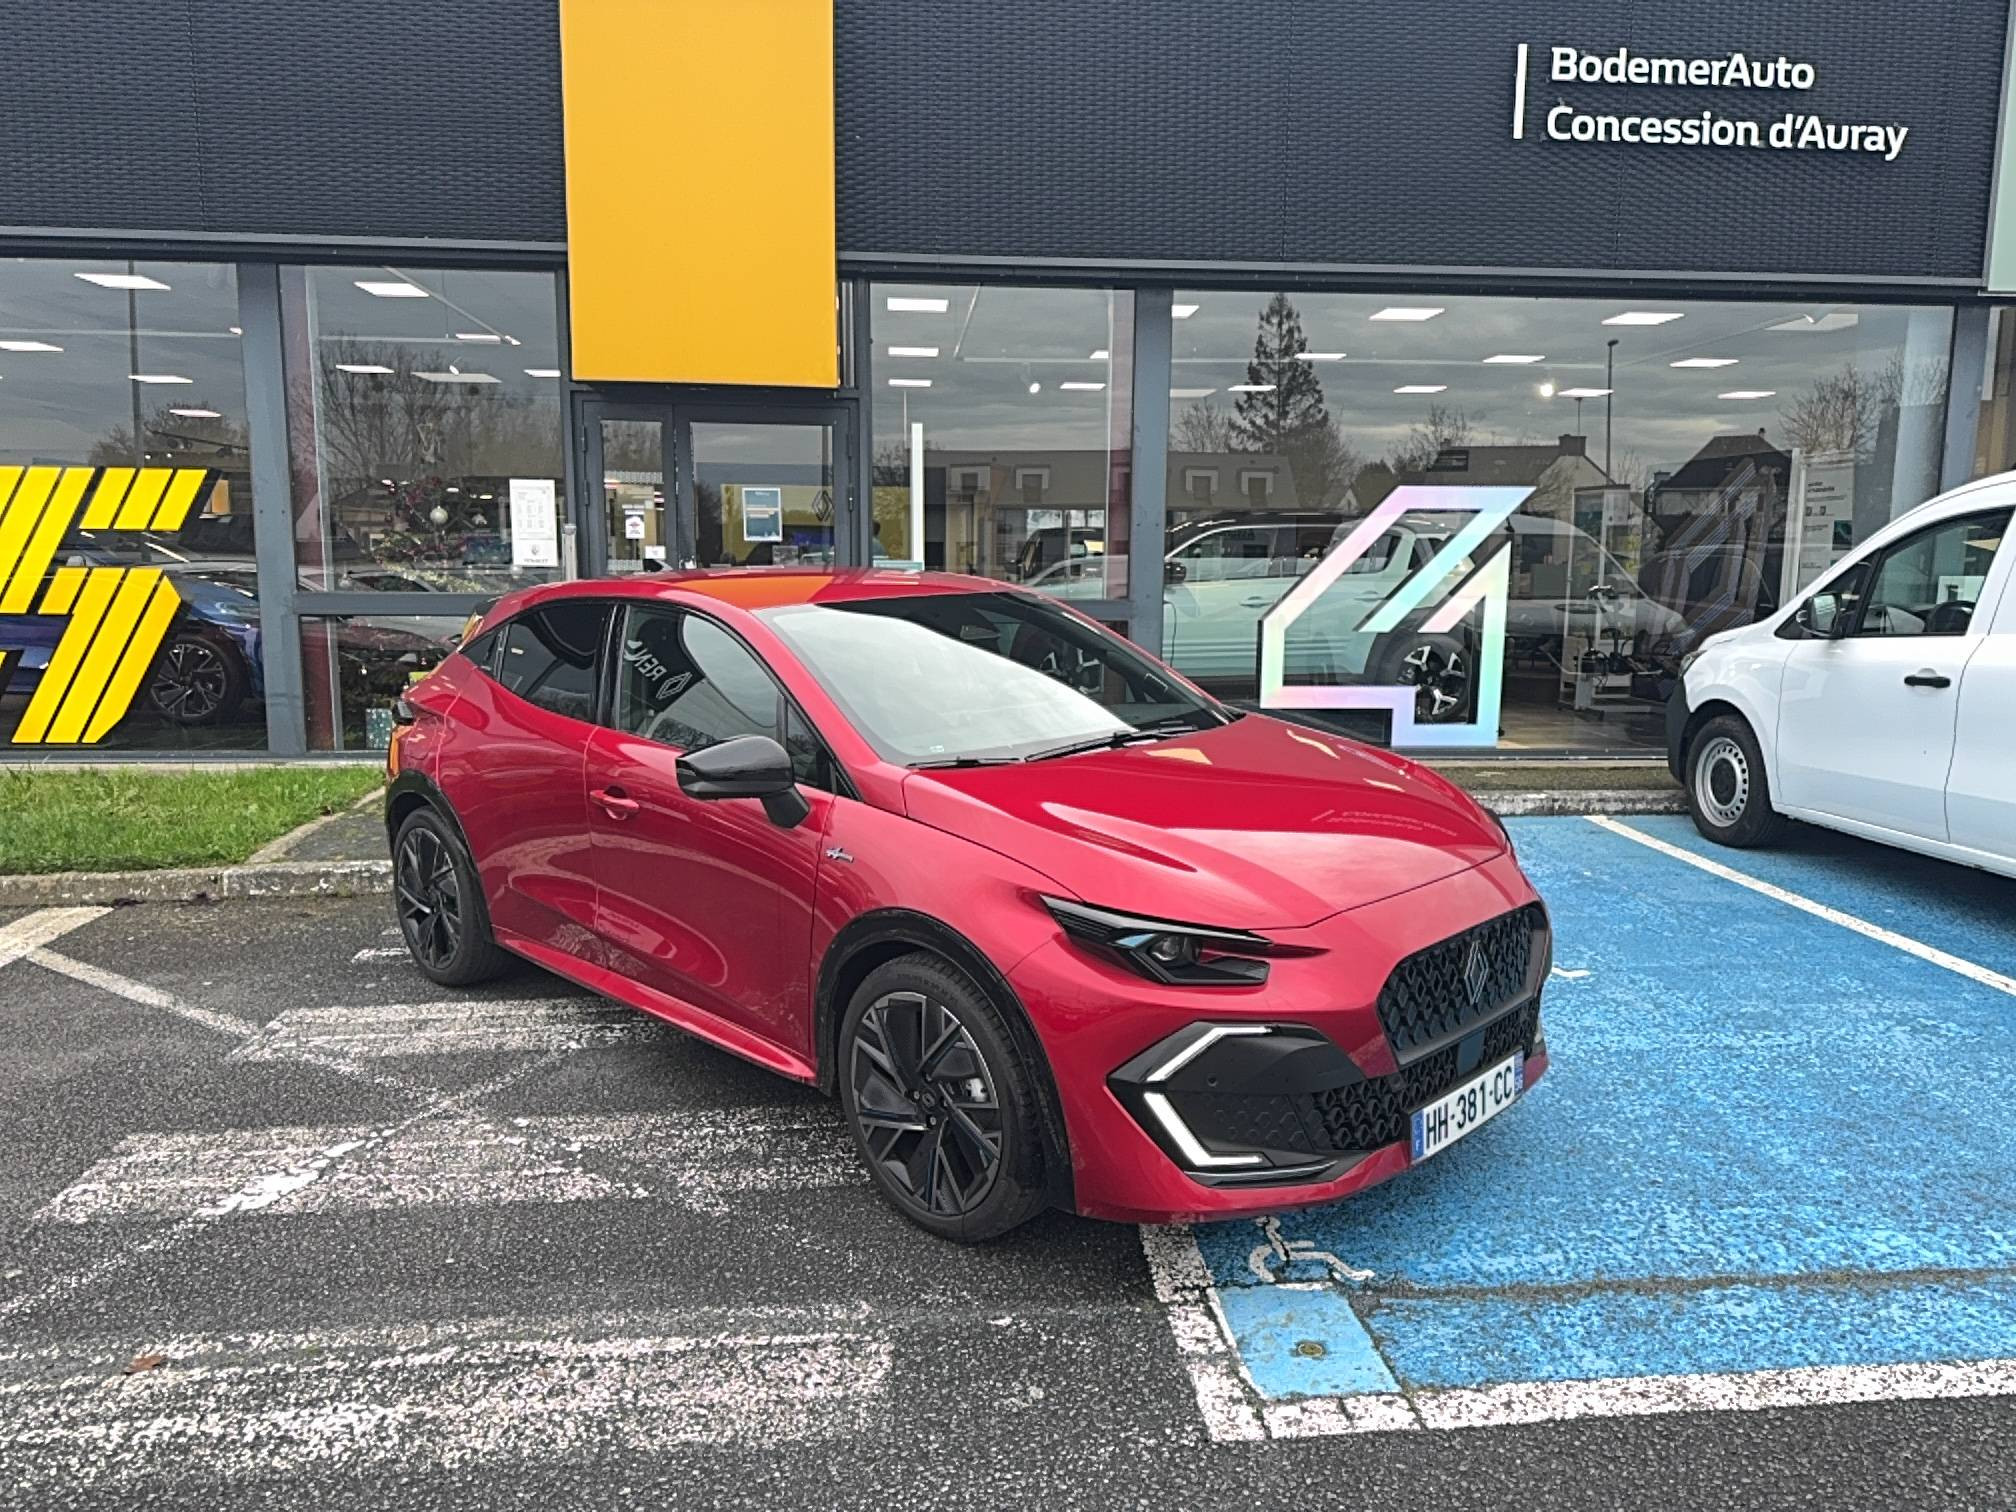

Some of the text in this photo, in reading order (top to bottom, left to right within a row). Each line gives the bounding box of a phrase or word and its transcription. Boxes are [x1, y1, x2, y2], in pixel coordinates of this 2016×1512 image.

[1551, 46, 1815, 90] BodemerAuto
[1547, 105, 1908, 161] Concession d'Auray
[1426, 1065, 1512, 1149] HH-381-CC
